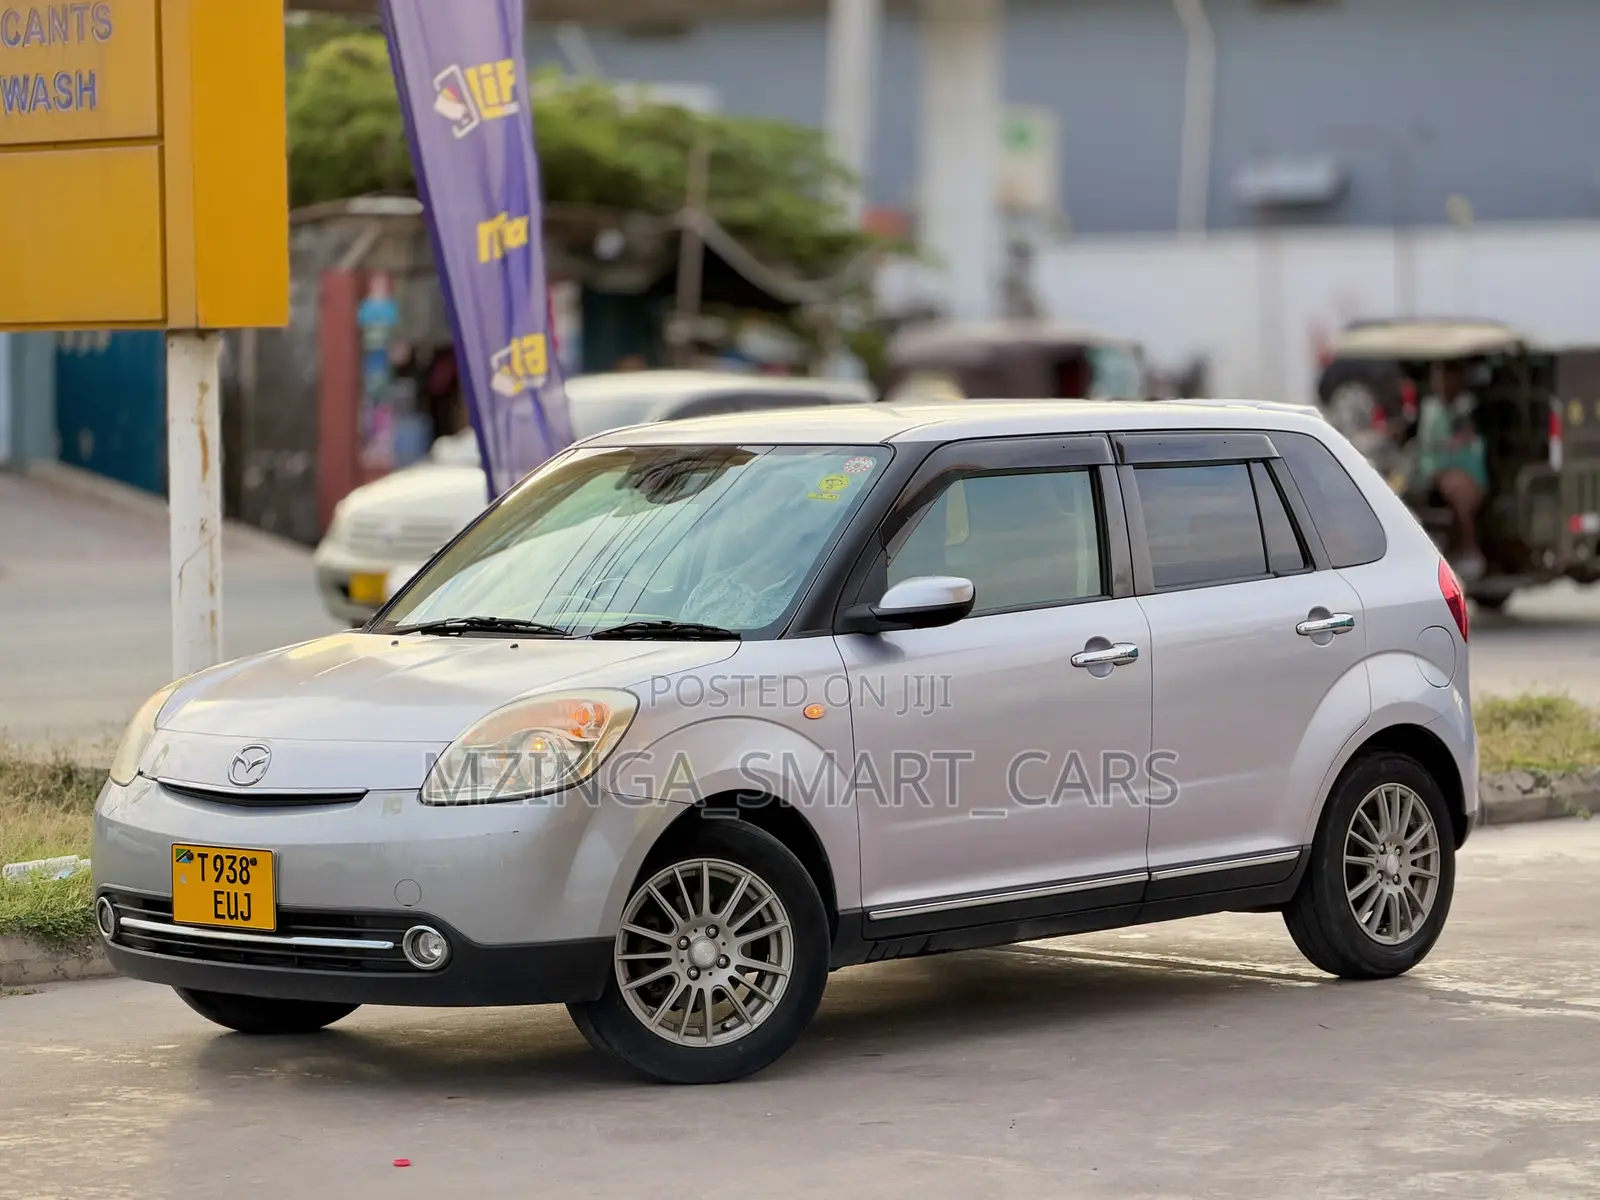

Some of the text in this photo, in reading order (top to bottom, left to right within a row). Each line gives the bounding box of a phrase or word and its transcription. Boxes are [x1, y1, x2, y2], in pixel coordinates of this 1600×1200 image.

[0, 70, 97, 115] WASH
[197, 853, 251, 885] T 938
[213, 890, 251, 921] EUJ
